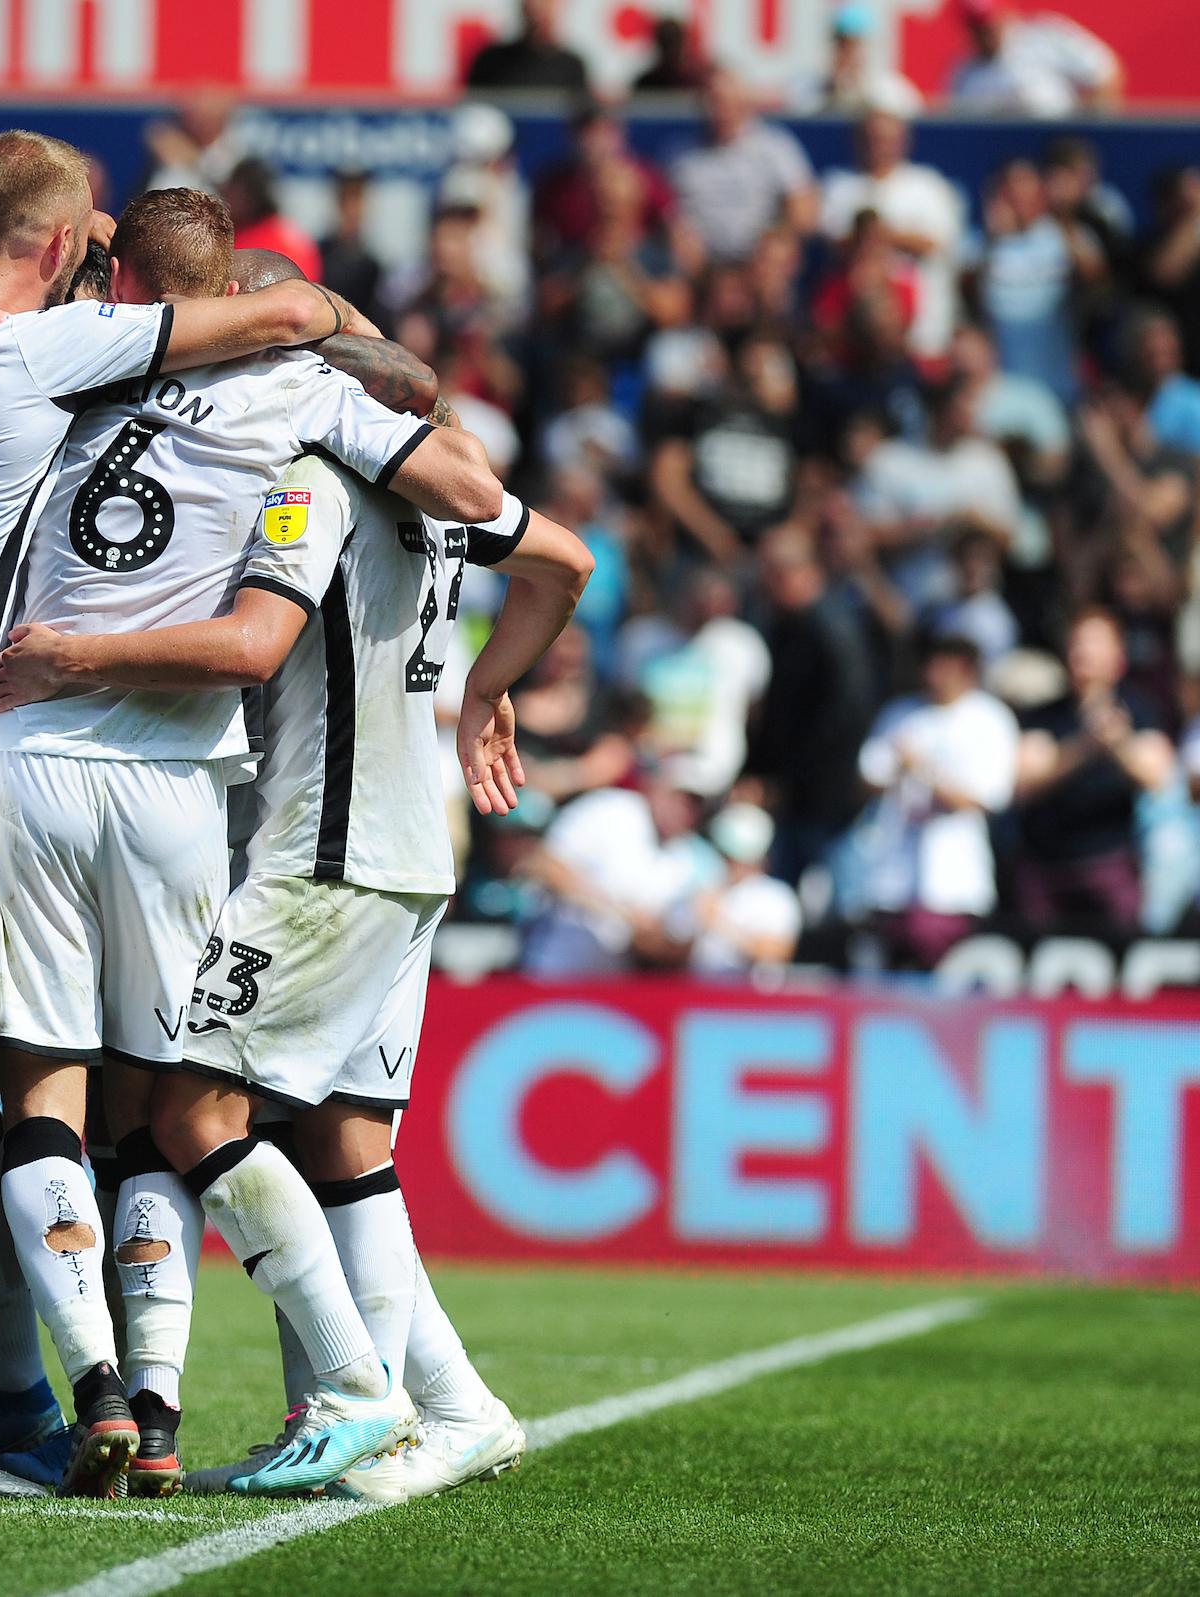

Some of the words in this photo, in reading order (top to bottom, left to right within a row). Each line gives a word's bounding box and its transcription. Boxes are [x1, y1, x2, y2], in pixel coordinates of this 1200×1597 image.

[69, 420, 175, 572] 6
[266, 494, 285, 506] sky
[287, 492, 309, 502] bet
[447, 1000, 1200, 1253] CENT
